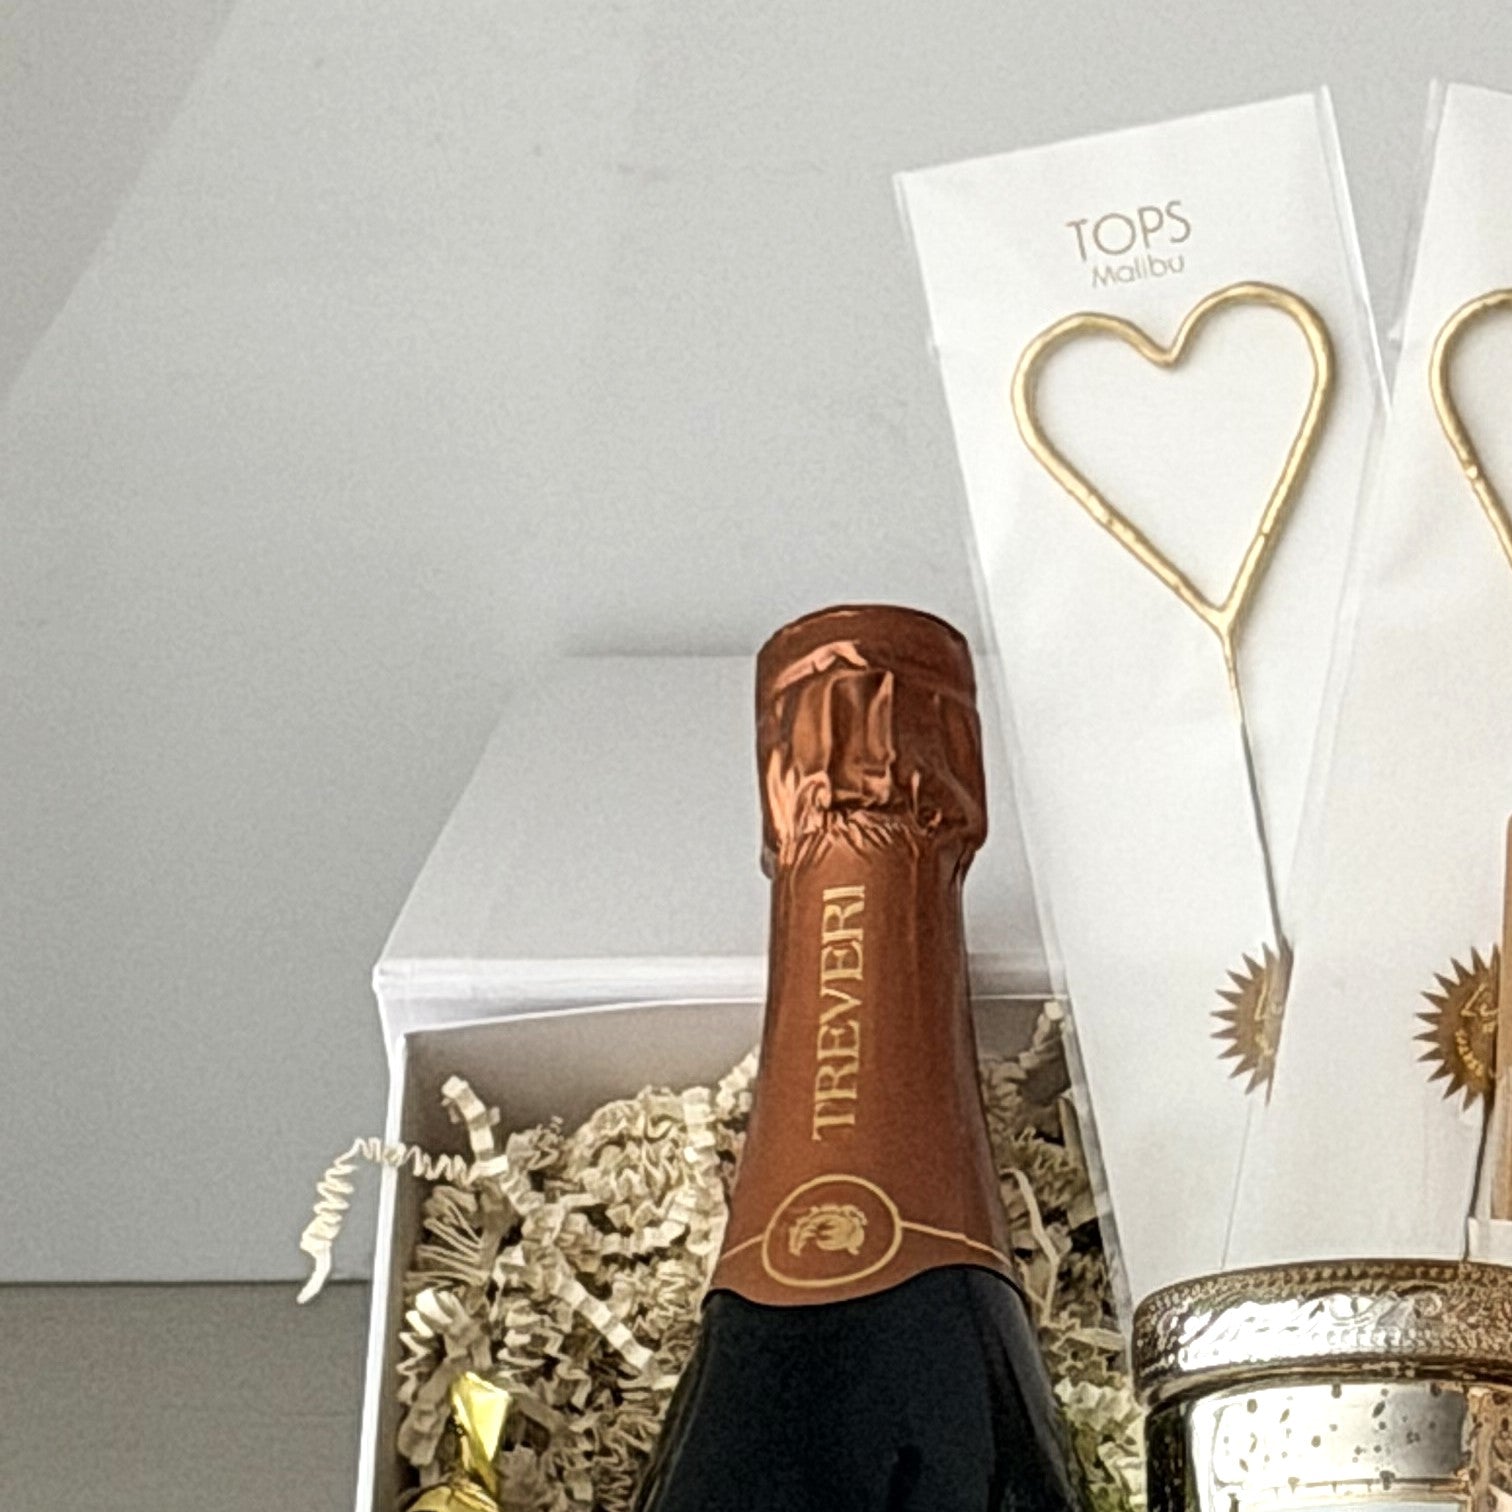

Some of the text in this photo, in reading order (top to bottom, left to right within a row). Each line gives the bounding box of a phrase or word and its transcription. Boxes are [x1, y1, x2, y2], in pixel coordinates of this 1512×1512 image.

[1065, 200, 1192, 264] TOPS
[1090, 249, 1187, 290] Malibu
[811, 885, 866, 1142] TREVERI
